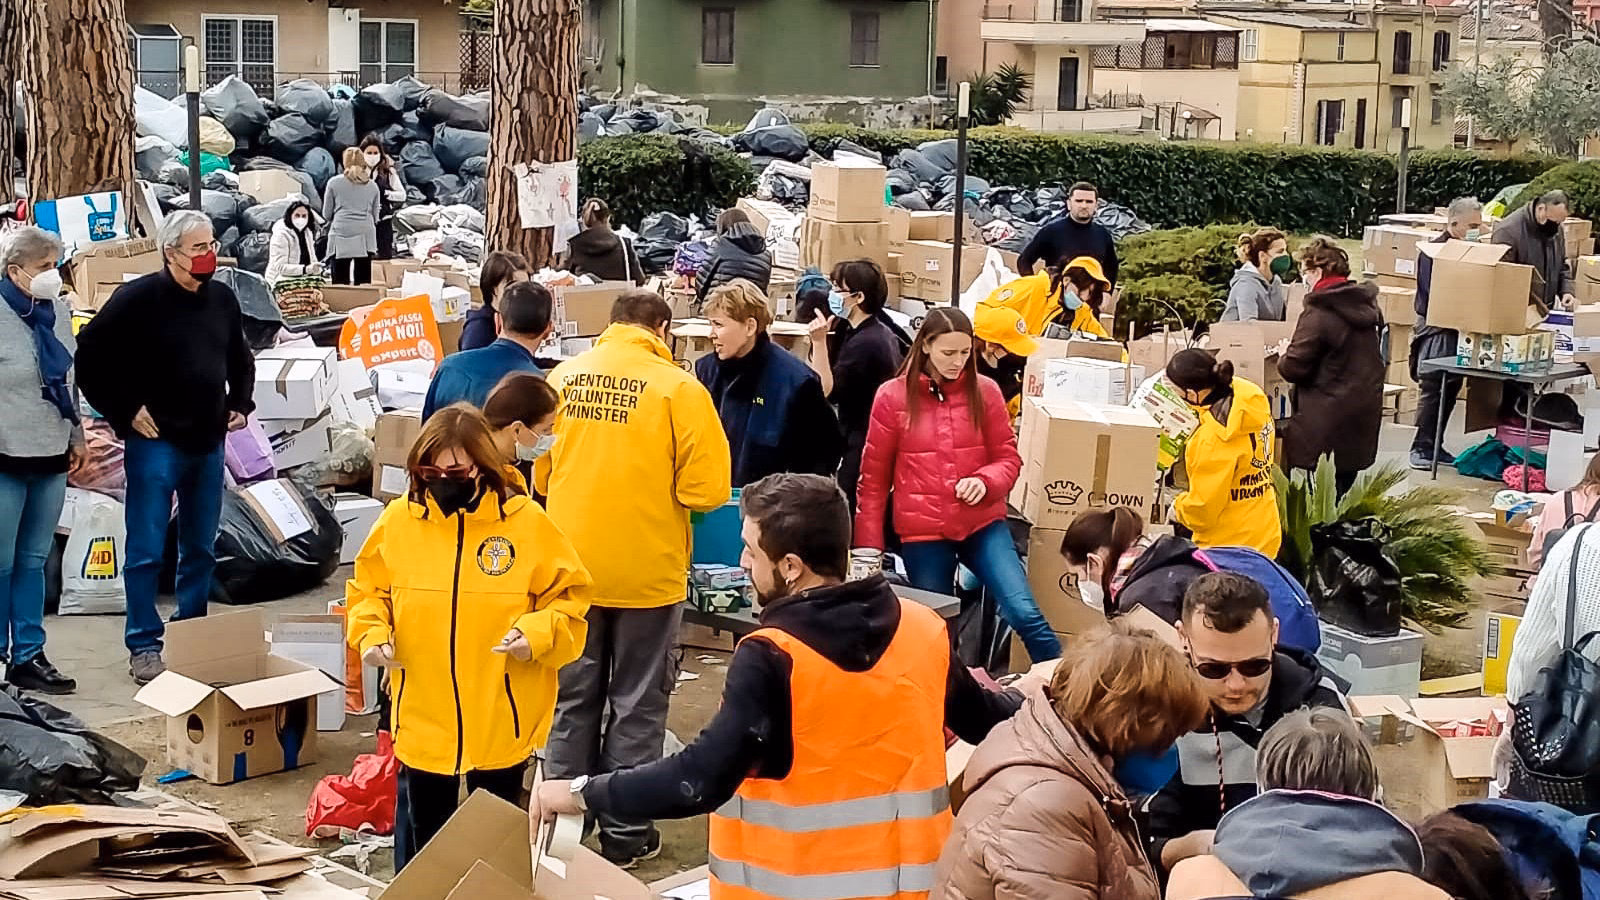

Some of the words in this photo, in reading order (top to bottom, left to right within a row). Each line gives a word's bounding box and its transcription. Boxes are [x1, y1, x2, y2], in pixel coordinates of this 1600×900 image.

[368, 318, 397, 332] PRIMA
[398, 312, 423, 324] PASSA
[370, 328, 394, 347] DA
[395, 322, 425, 340] NOI!
[370, 347, 418, 363] expert
[562, 373, 648, 394] SCIENTOLOGY
[562, 389, 638, 409] VOLUNTEER
[565, 404, 629, 424] MINISTER
[90, 550, 112, 566] MD
[244, 728, 254, 746] 8
